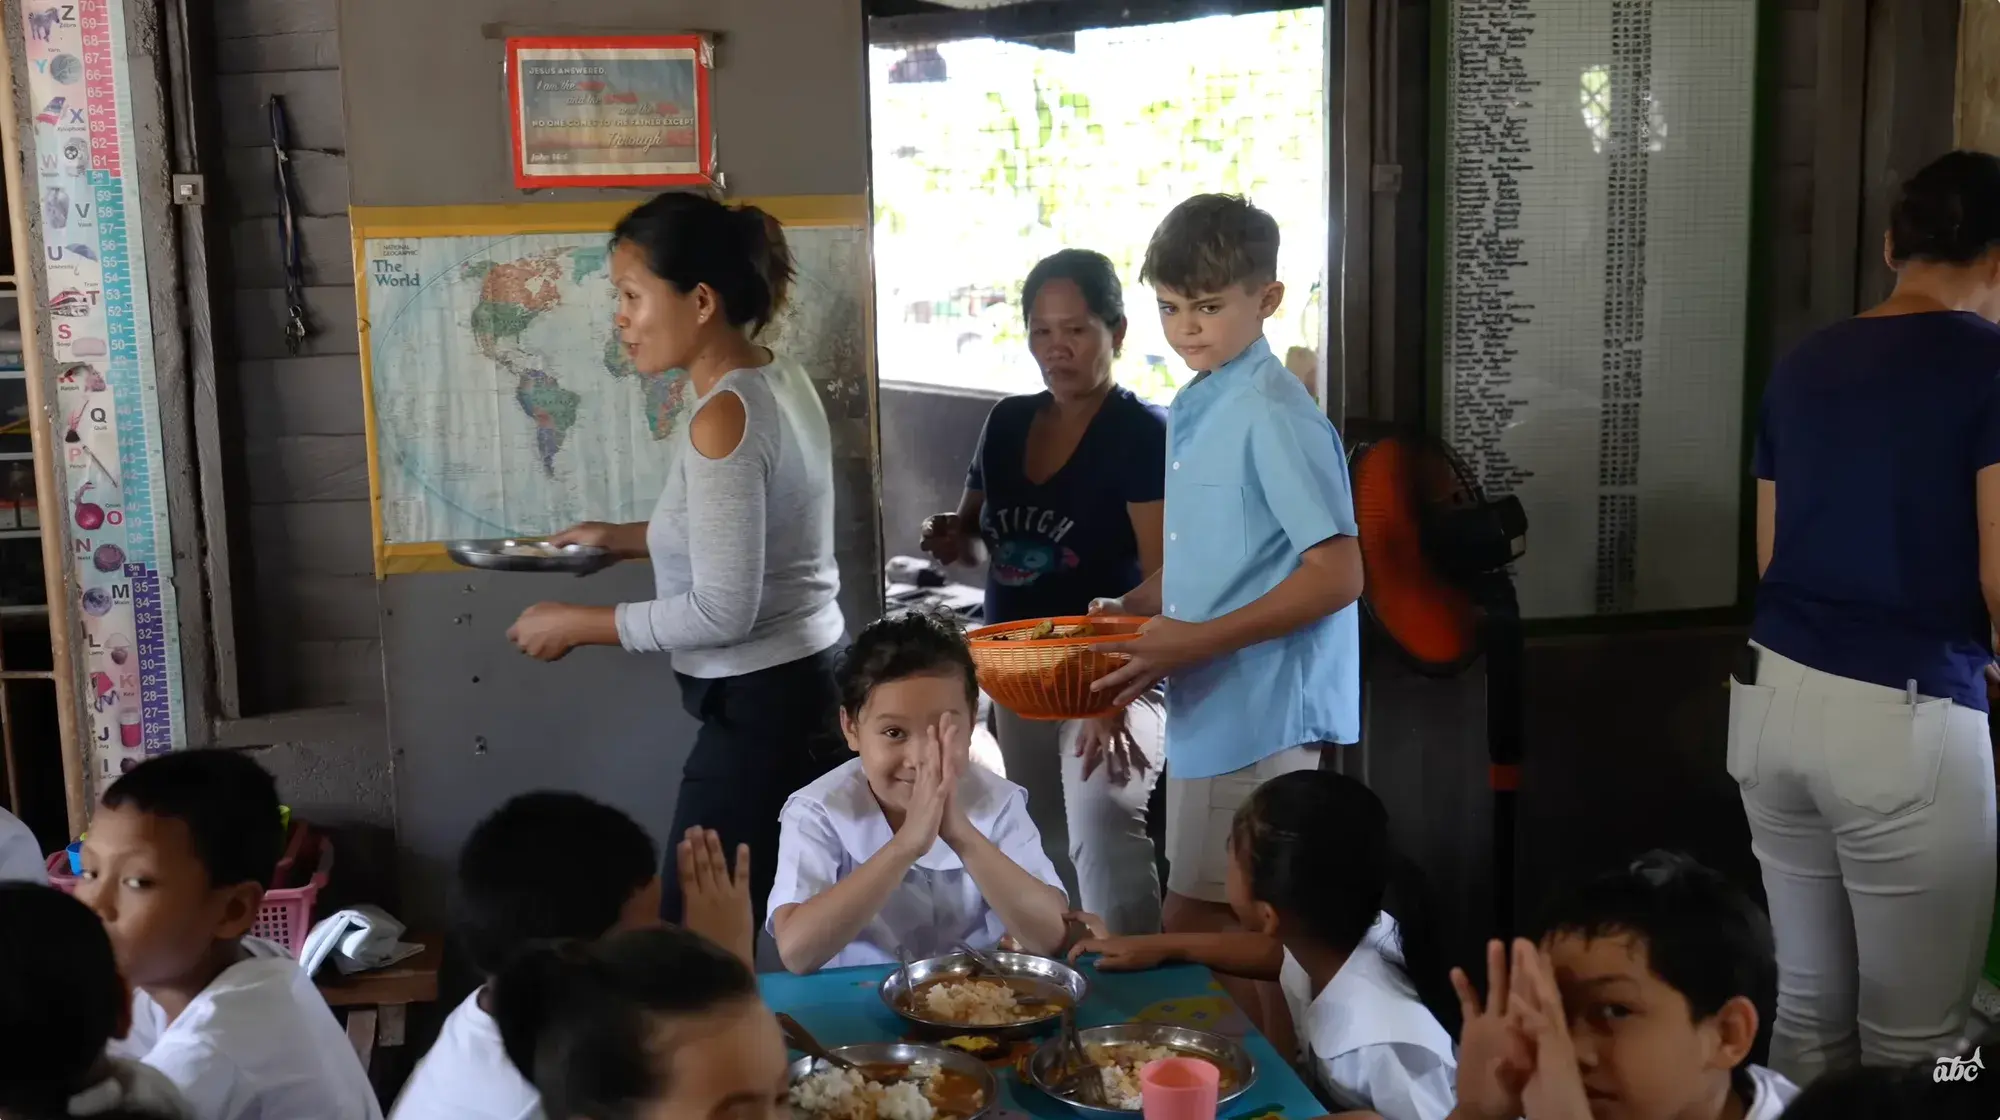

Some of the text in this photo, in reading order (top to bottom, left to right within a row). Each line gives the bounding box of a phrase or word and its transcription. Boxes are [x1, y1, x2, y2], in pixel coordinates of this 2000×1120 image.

[81, 0, 96, 11] 70
[61, 5, 75, 20] Z
[82, 18, 97, 29] 69
[83, 35, 99, 46] 68
[85, 53, 100, 63] 67
[35, 59, 47, 74] Y
[529, 67, 556, 75] JESUS
[86, 70, 101, 81] 66
[536, 80, 543, 90] I
[561, 79, 576, 91] the
[87, 87, 103, 98] 65
[88, 105, 104, 115] 64
[70, 109, 84, 124] X
[546, 119, 566, 127] ONE
[600, 119, 612, 127] TO
[631, 118, 661, 126] FATHER
[663, 117, 695, 126] EXCEPT
[90, 121, 106, 132] 63
[91, 138, 107, 149] 62
[608, 130, 662, 153] Through
[42, 154, 58, 169] W
[93, 155, 107, 166] 61
[96, 190, 111, 201] 59
[75, 203, 90, 218] V
[98, 207, 113, 218] 58
[100, 223, 115, 234] 57
[101, 240, 116, 251] 56
[47, 246, 63, 261] U
[103, 256, 118, 267] 55
[372, 259, 402, 273] The
[104, 273, 119, 283] 54
[374, 272, 420, 287] World
[86, 290, 100, 305] T
[106, 290, 121, 300] 53
[107, 306, 123, 316] 52
[58, 324, 72, 339] S
[110, 323, 124, 334] 51
[111, 339, 125, 350] 50
[90, 407, 107, 424] Q
[69, 448, 82, 462] P
[107, 510, 123, 525] O
[983, 506, 1074, 543] STITCH
[75, 538, 91, 553] N
[112, 584, 130, 599] M
[134, 582, 148, 593] 35
[136, 598, 150, 608] 34
[137, 613, 151, 624] 33
[138, 628, 152, 639] 32
[89, 634, 101, 647] L
[139, 644, 153, 655] 31
[140, 659, 155, 670] 30
[119, 674, 134, 688] K
[142, 675, 156, 686] 29
[143, 691, 157, 702] 28
[144, 706, 158, 717] 27
[146, 722, 159, 733] 26
[98, 727, 109, 741] J
[146, 738, 160, 749] 25
